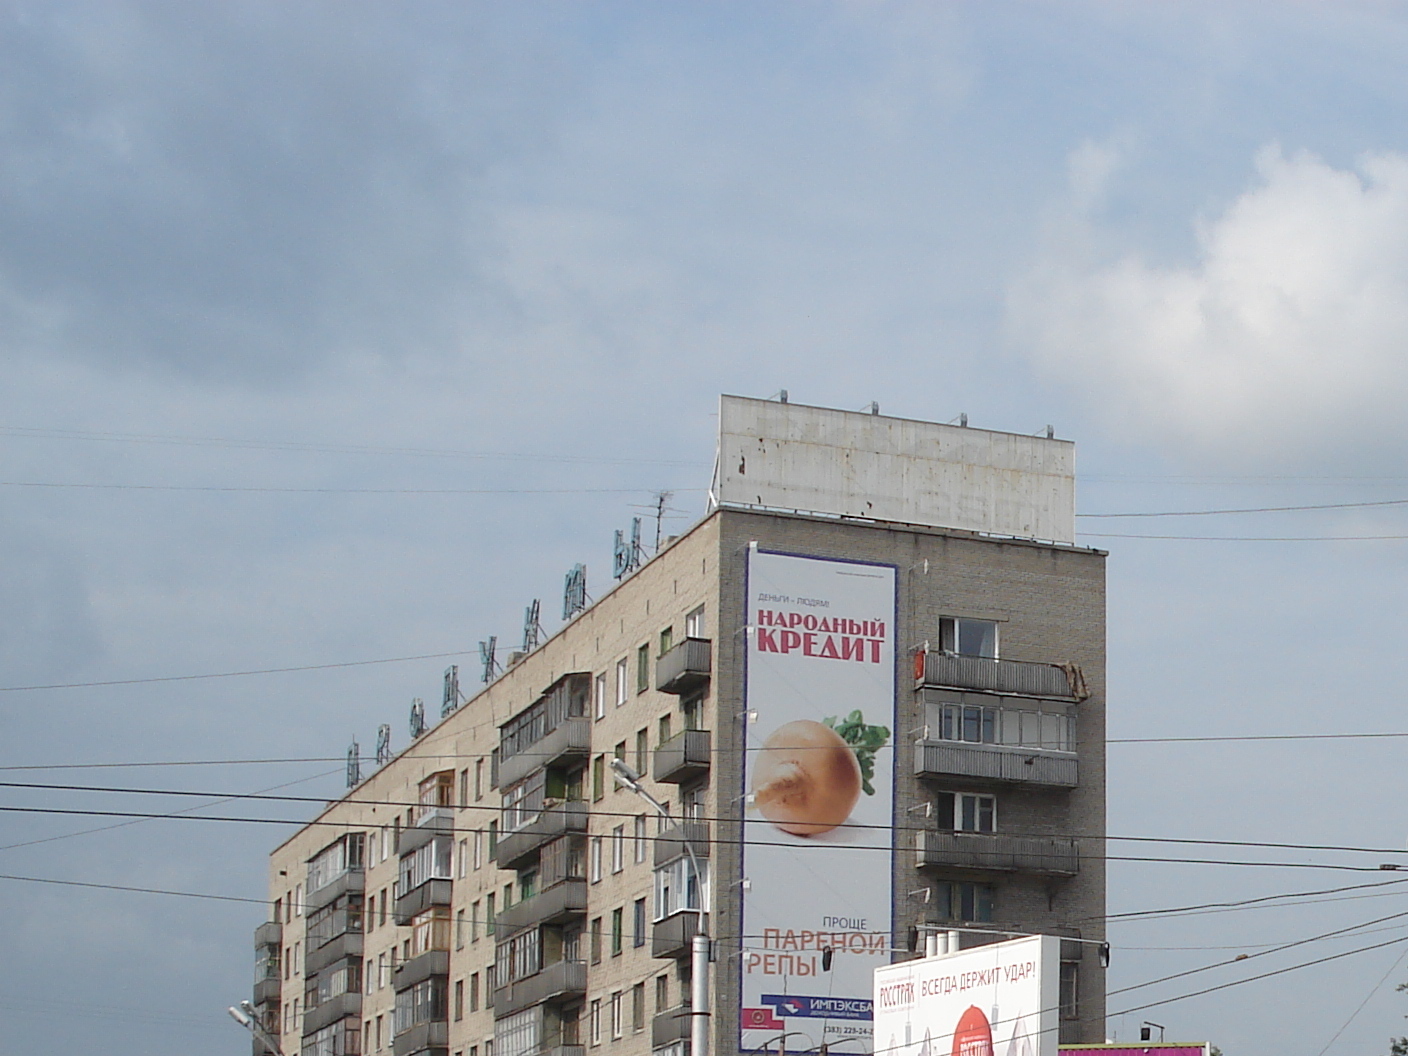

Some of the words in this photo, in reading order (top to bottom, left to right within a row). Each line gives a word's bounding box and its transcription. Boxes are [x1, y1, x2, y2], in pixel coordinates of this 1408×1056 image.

[758, 593, 790, 605] ДЕНЬГИ
[758, 610, 885, 638] НАРОДНЫЙ
[758, 628, 884, 663] КРЕДИТ
[823, 916, 867, 930] ПРОЩЕ
[764, 928, 885, 956] ПАРЕНОЙ
[747, 953, 816, 976] РЕПЫ
[921, 976, 957, 997] ВСЕГДА
[960, 967, 1002, 992] ДЕРЖИТ
[1004, 961, 1036, 983] УДАР!
[810, 999, 873, 1012] ИМПЭКСБА
